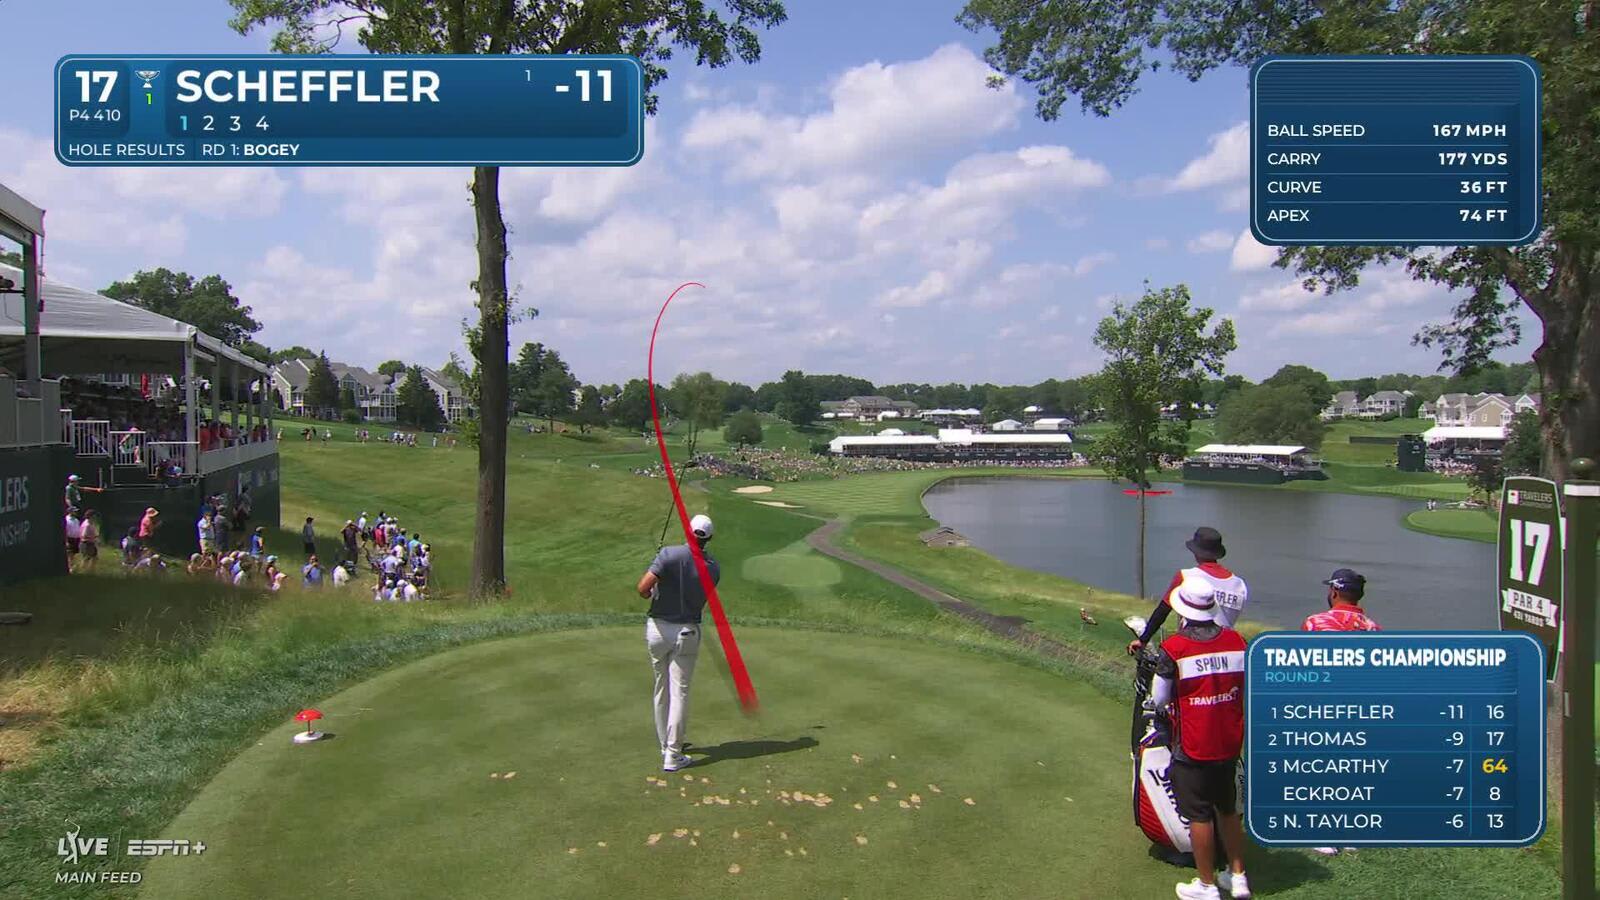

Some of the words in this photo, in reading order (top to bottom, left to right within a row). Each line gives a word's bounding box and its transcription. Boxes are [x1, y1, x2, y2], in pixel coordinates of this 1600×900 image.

[1510, 518, 1551, 587] 17
[1513, 591, 1533, 610] PAR
[1536, 599, 1544, 613] 4
[1195, 656, 1229, 673] SPAUN
